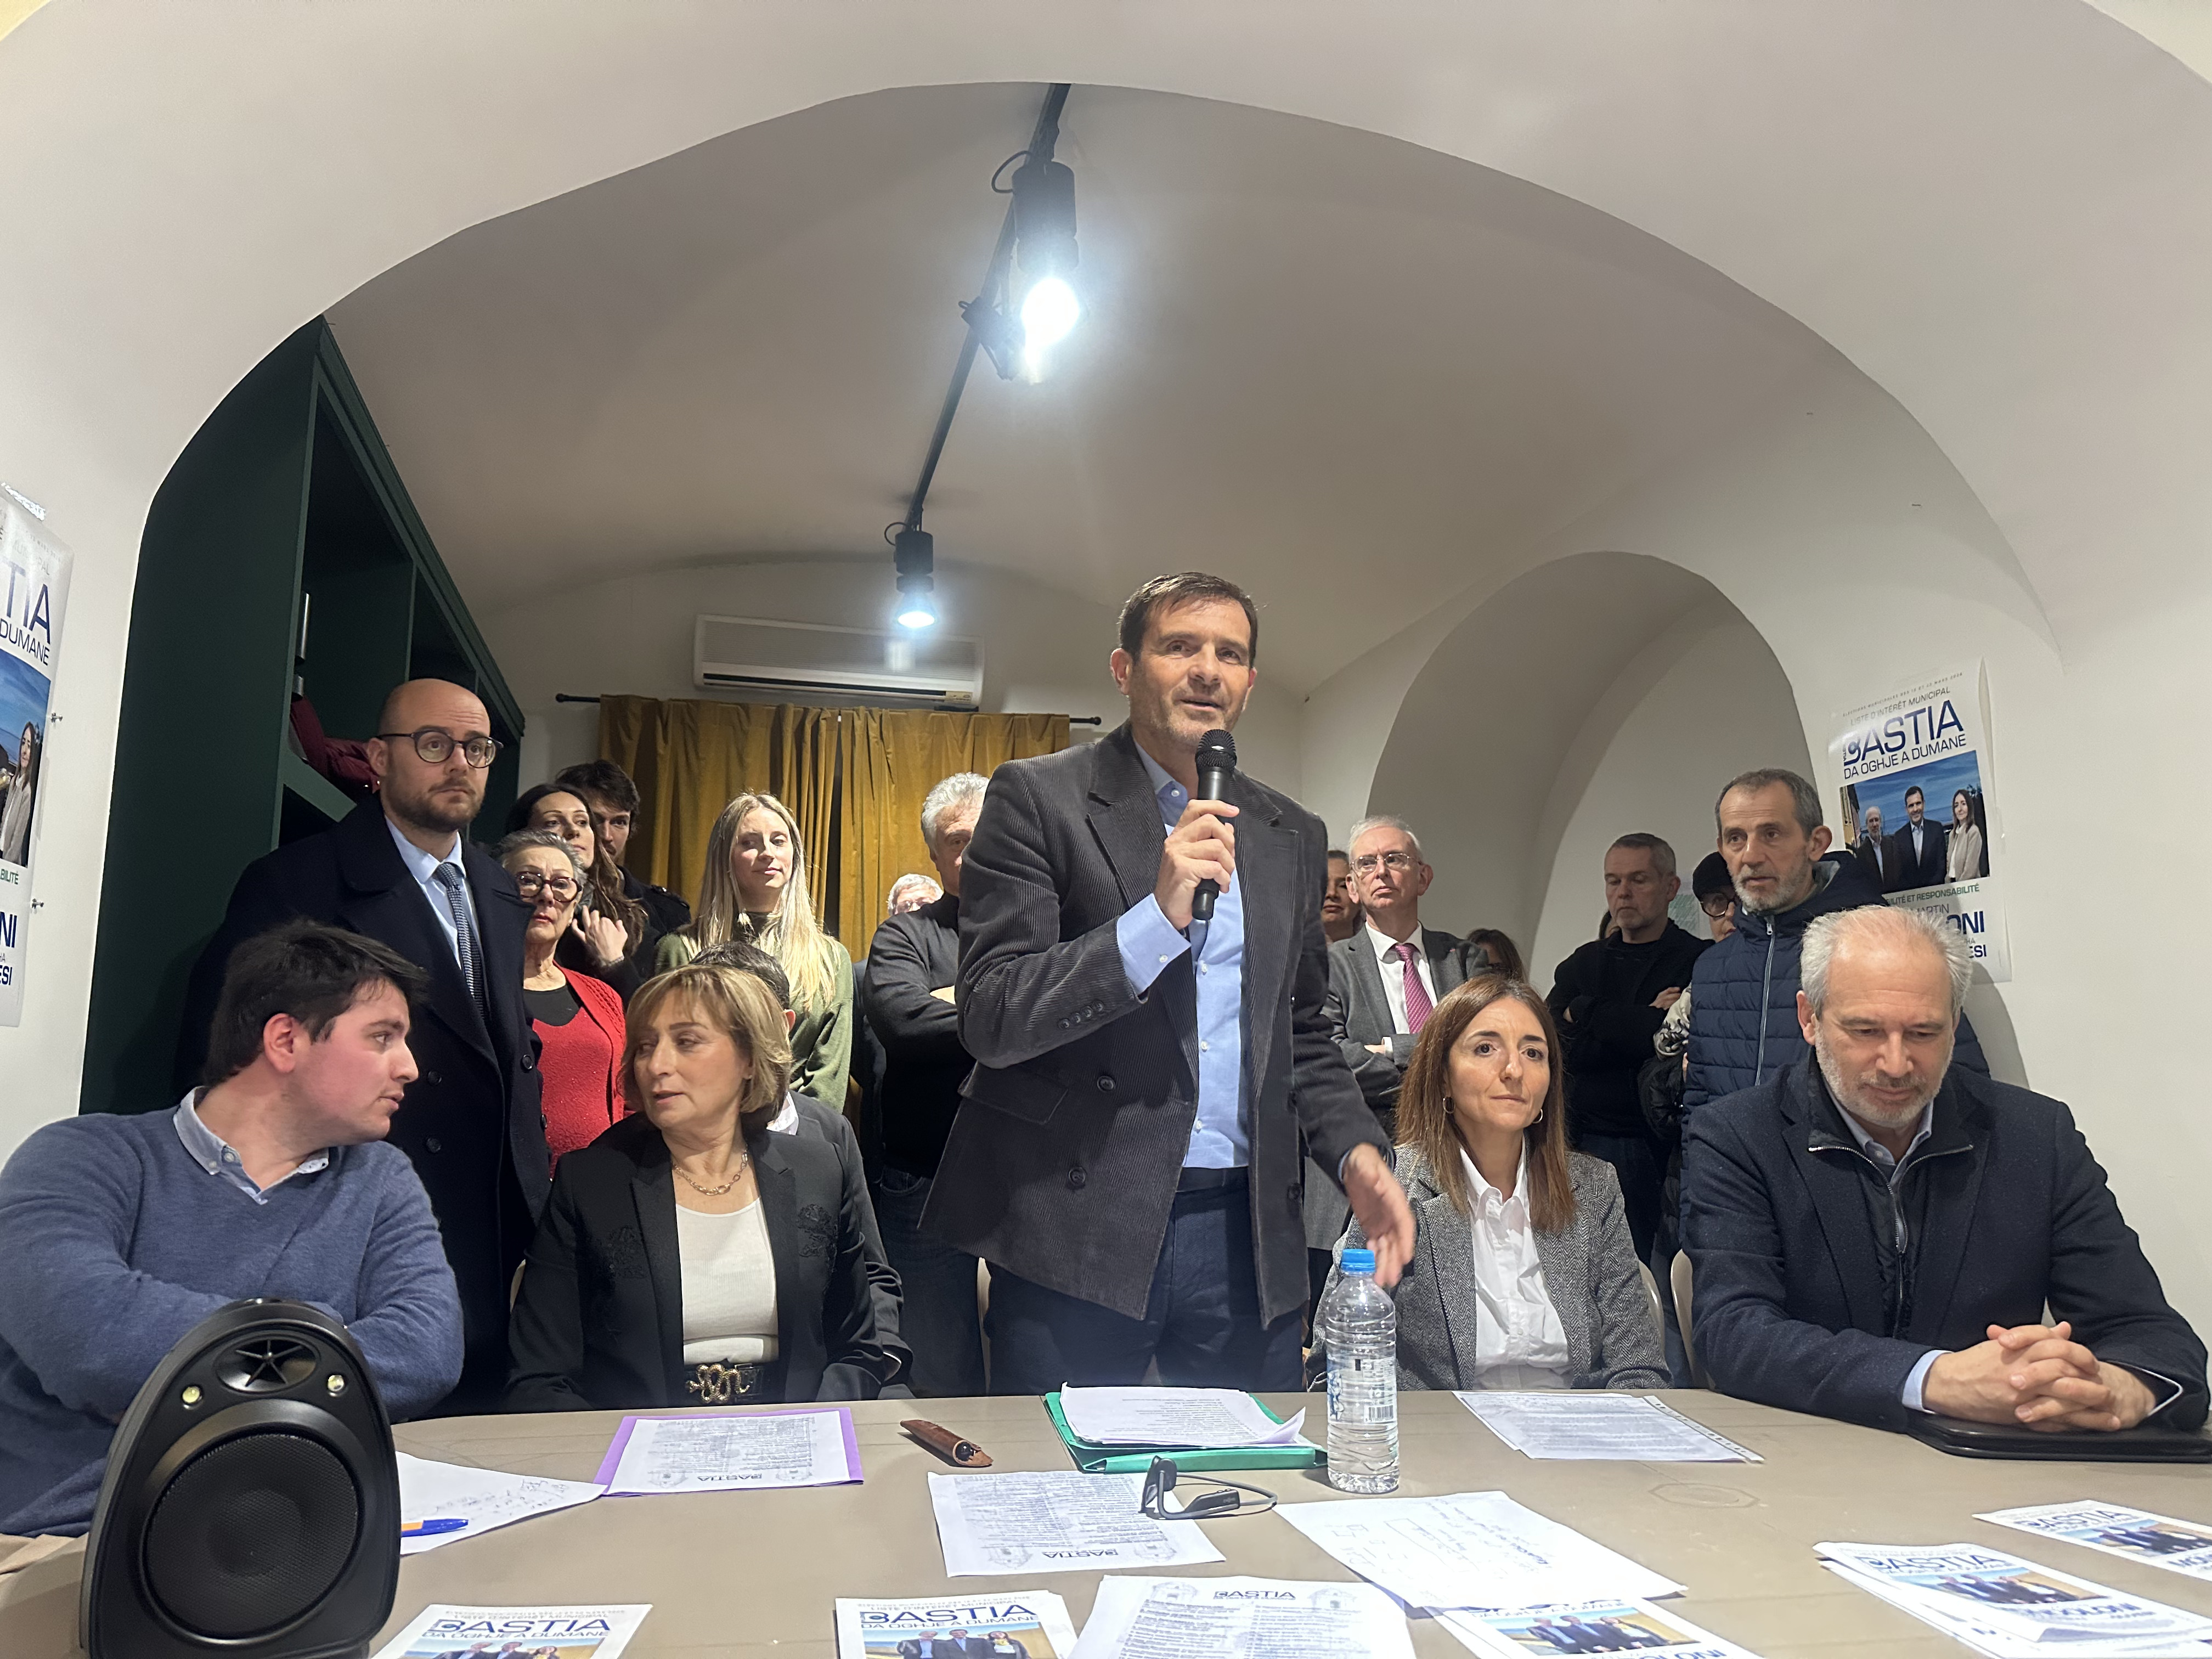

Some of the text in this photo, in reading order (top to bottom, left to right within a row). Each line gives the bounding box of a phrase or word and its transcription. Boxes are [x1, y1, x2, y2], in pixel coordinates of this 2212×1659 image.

[0, 618, 50, 665] DUMANE
[1908, 686, 1951, 706] MUNICIPAL
[1844, 733, 1966, 780] DA OGHJE A DUMANE
[1907, 894, 1915, 902] ET
[1917, 883, 1979, 901] RESPONSABILITÉ
[860, 1605, 1037, 1624] BASTIA
[427, 1618, 611, 1633] BASTIA
